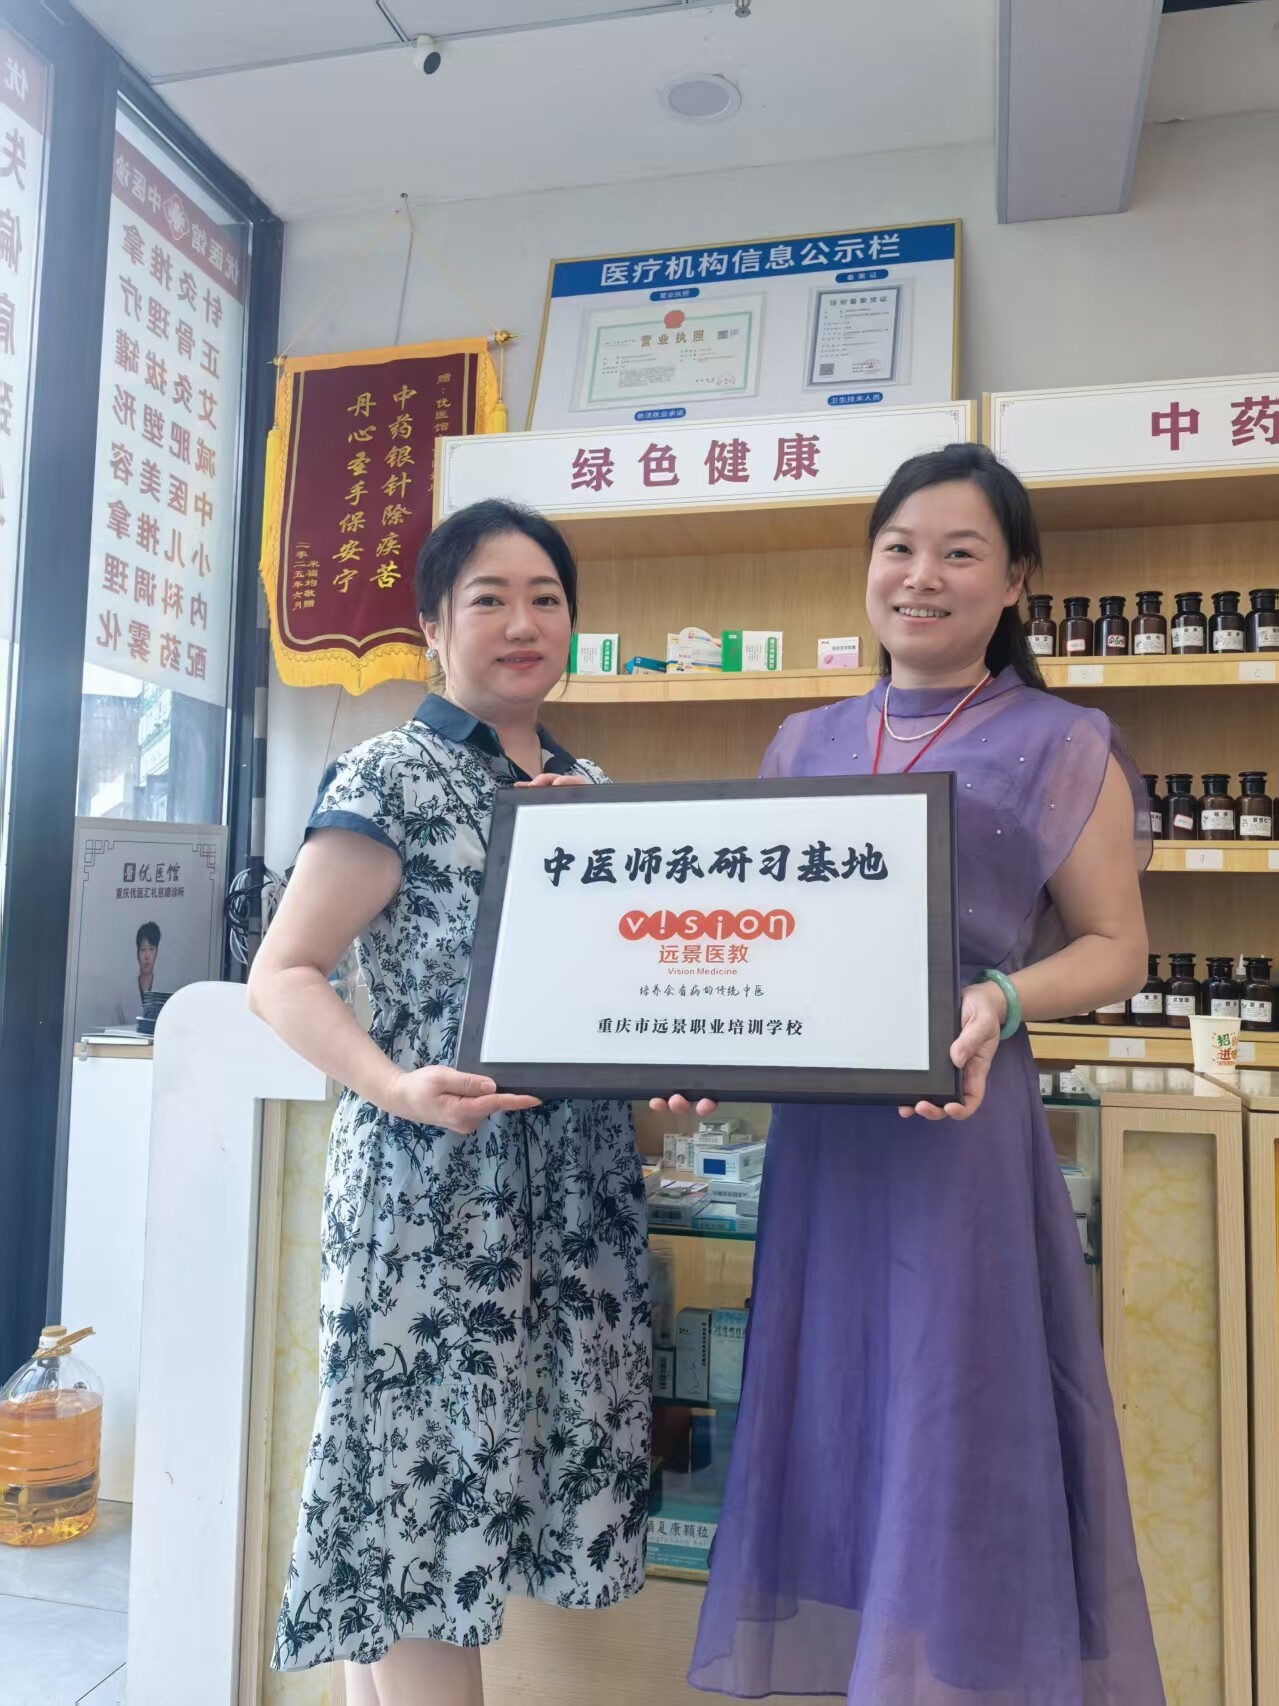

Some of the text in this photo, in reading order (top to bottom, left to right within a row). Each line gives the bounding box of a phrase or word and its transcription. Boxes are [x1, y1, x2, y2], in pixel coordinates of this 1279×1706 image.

[600, 233, 901, 286] 医疗机构信息公示栏
[640, 329, 705, 347] 营业执照
[1151, 396, 1279, 450] 中药
[571, 432, 821, 492] 绿色健康
[332, 392, 376, 593] 丹心圣手保安宁
[369, 384, 418, 589] 中药银针除疾苦
[139, 862, 181, 882] 优医馆
[543, 840, 889, 887] 中医师承研习基地
[658, 944, 749, 964] 远景医教
[668, 967, 738, 976] Vision Medicine
[639, 983, 765, 998] 培养会看病的传统中医
[597, 1017, 803, 1036] 重庆市远景职业培训学校
